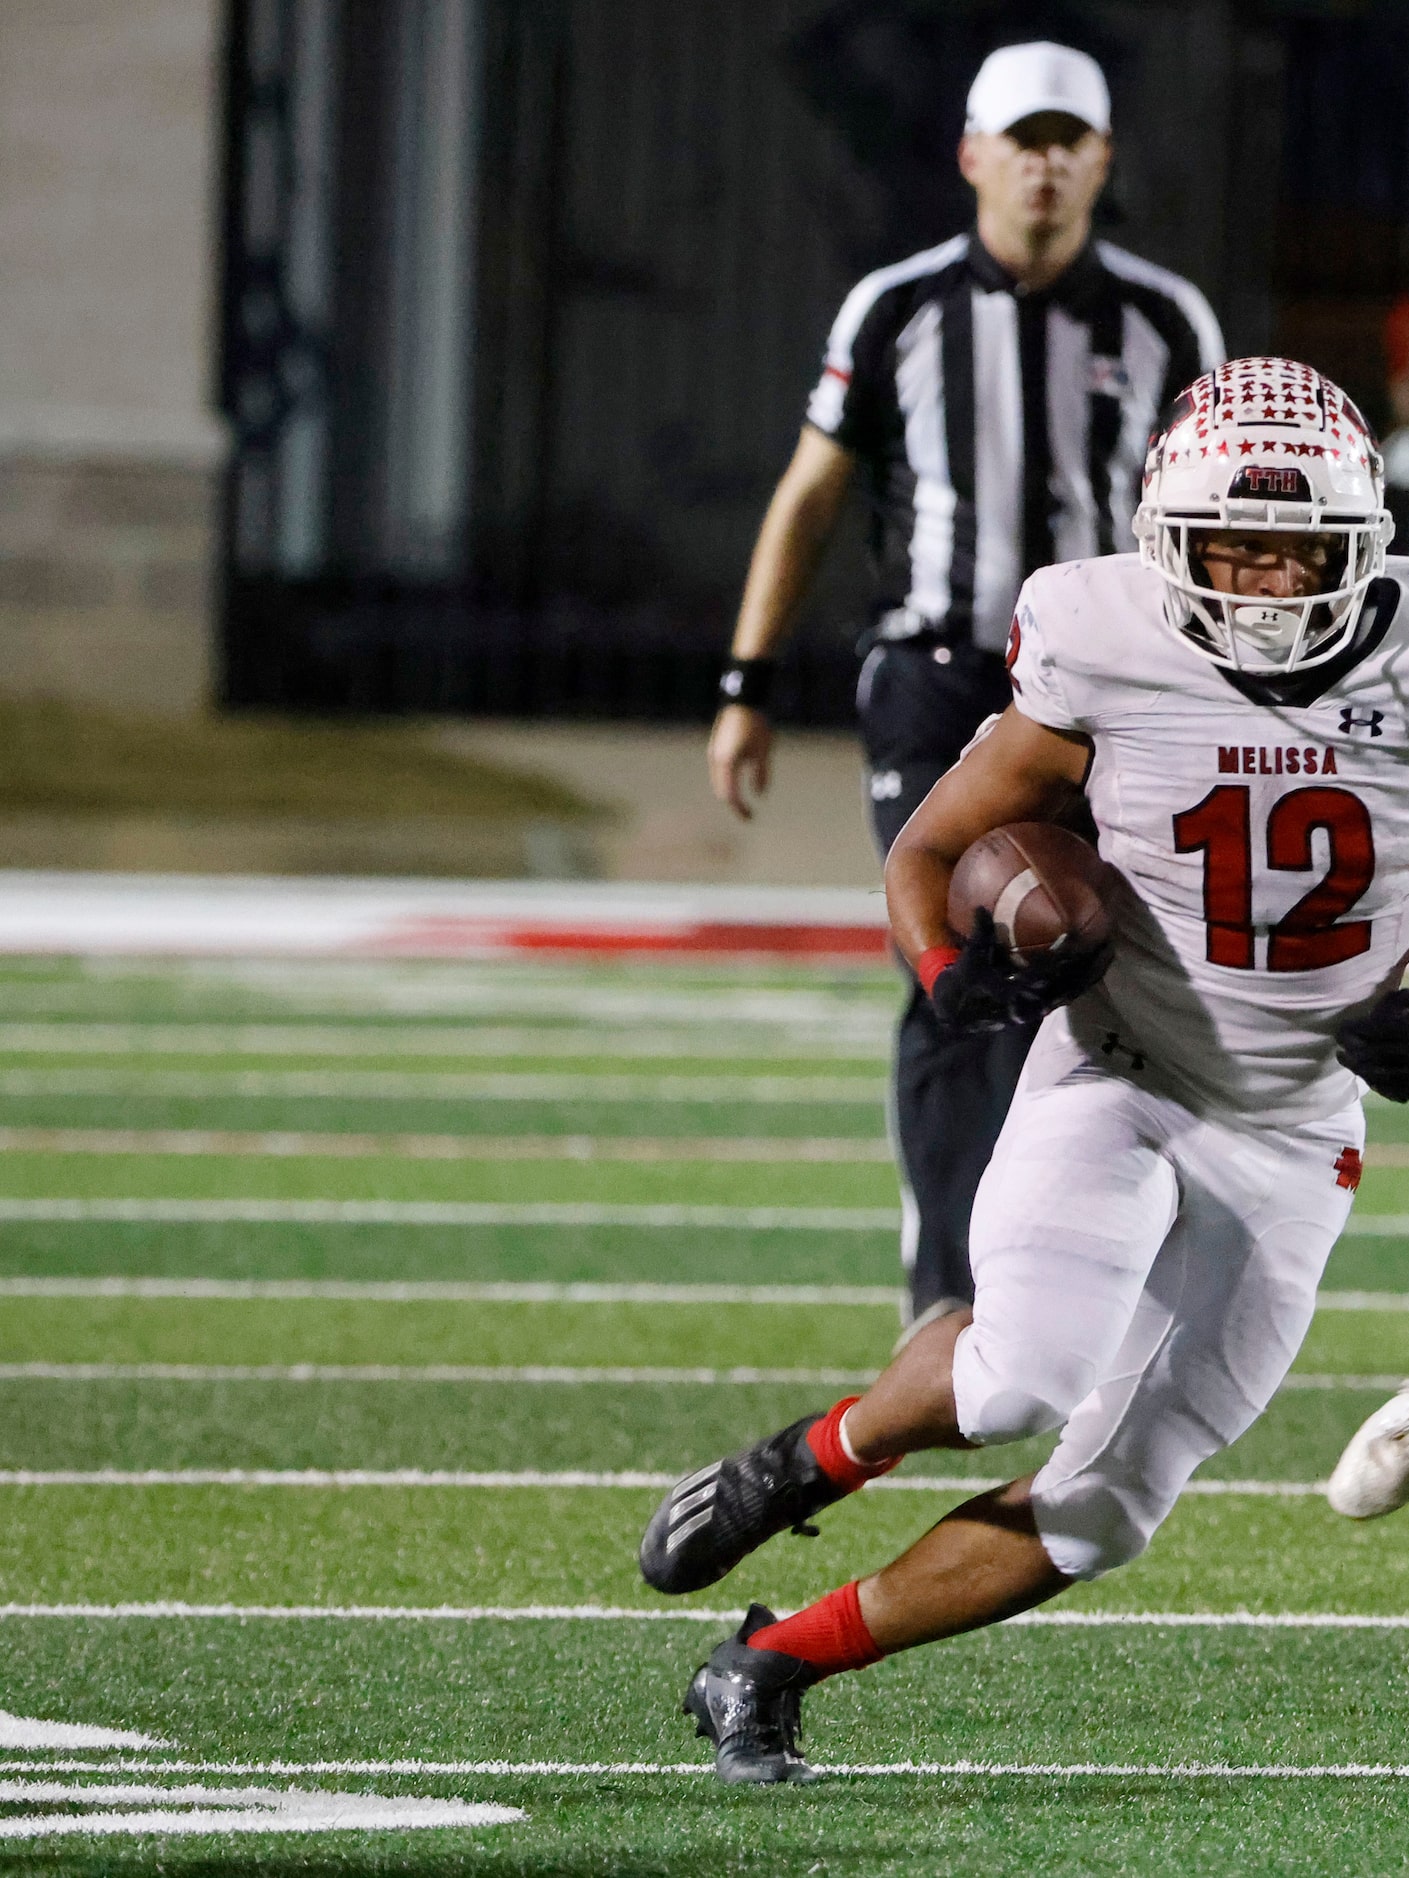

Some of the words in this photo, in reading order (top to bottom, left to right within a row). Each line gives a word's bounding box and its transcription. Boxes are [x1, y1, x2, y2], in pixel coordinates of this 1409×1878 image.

[1246, 469, 1298, 493] TTH
[1217, 746, 1338, 775] MELISSA
[1172, 784, 1375, 973] 12
